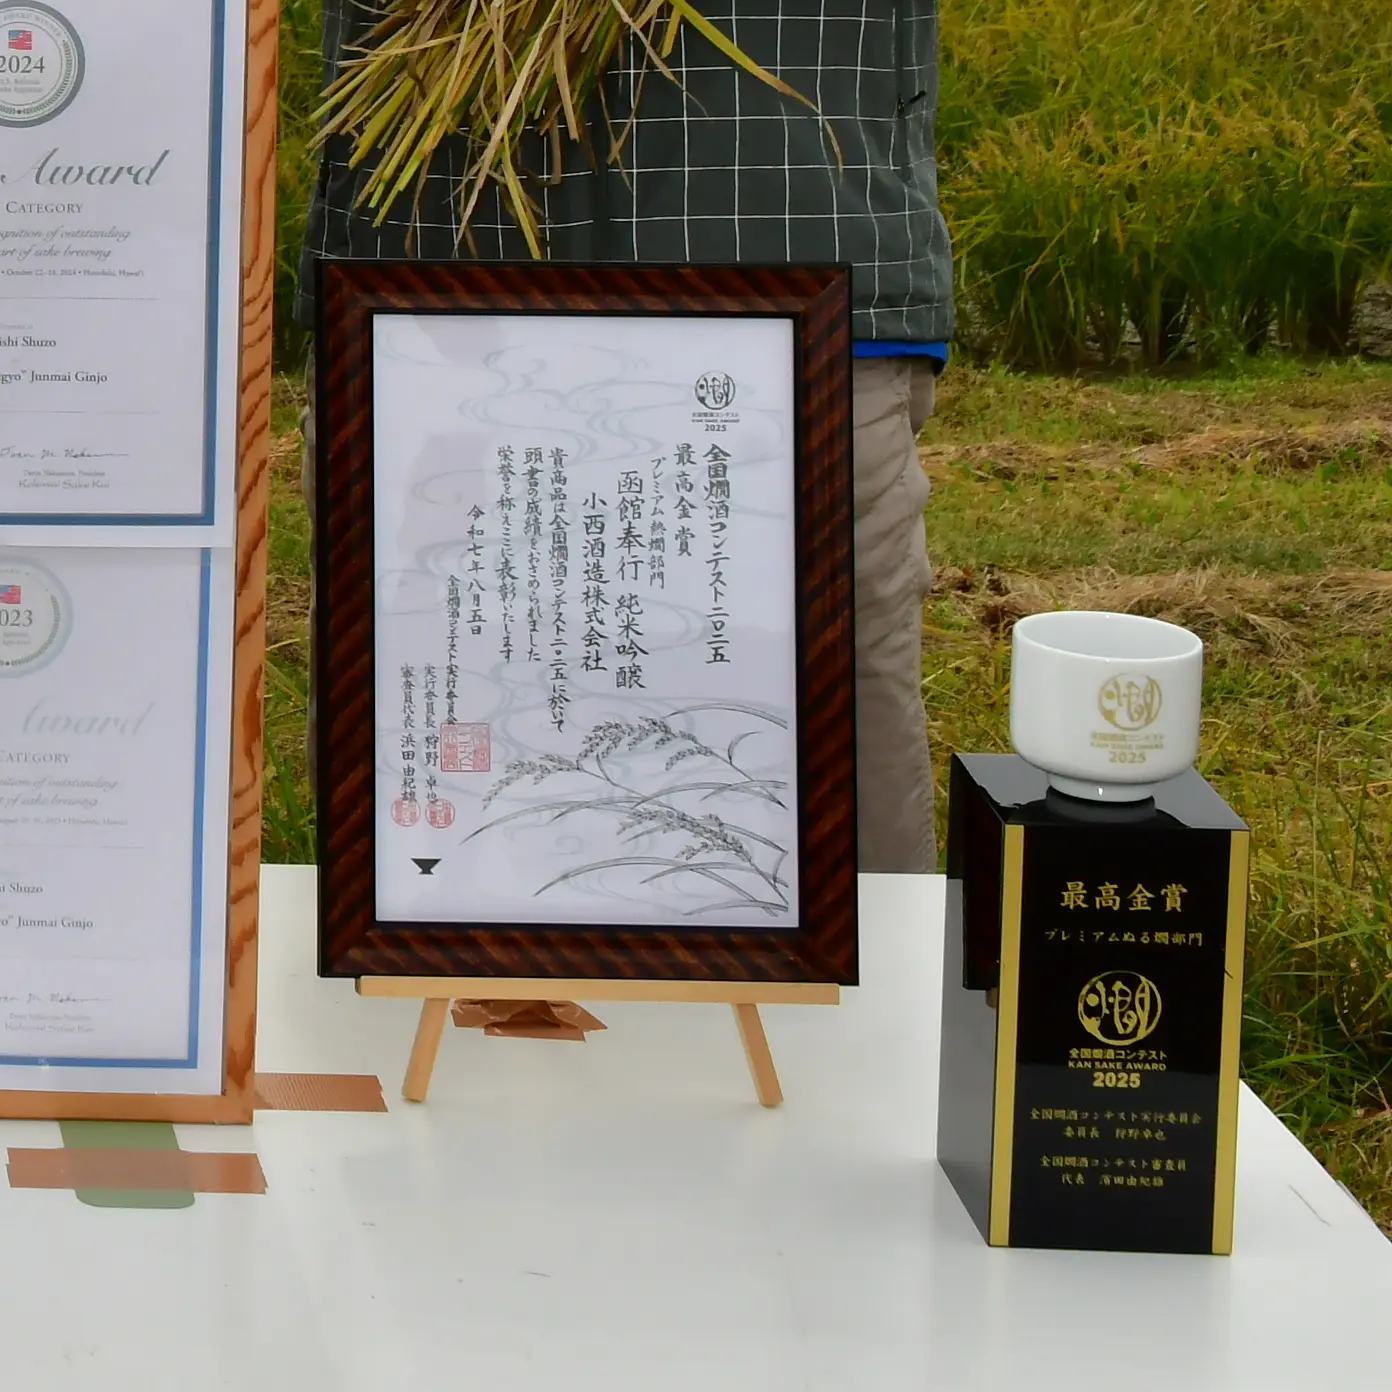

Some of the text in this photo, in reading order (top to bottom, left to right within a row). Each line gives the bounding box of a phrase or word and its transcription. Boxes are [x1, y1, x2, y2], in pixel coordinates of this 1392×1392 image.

[1, 146, 171, 186] Award
[6, 201, 82, 213] CATEGORY
[22, 336, 56, 347] Shuzo
[31, 371, 71, 383] Junmai
[75, 371, 107, 384] Ginjo
[704, 424, 726, 432] 2025
[673, 442, 698, 557] 最高金賞
[467, 504, 487, 635] 令和七年八月五日
[580, 492, 610, 672] 小西酒造株式会社
[614, 470, 648, 689] 函館奉行 純米吟醸
[10, 883, 43, 893] Shuzo
[1060, 881, 1187, 912] 最高金賞
[17, 916, 57, 928] Junmai
[61, 918, 93, 930] Ginjo
[1068, 1061, 1167, 1071] KAN SAKE AWARD
[1092, 1072, 1141, 1088] 2025
